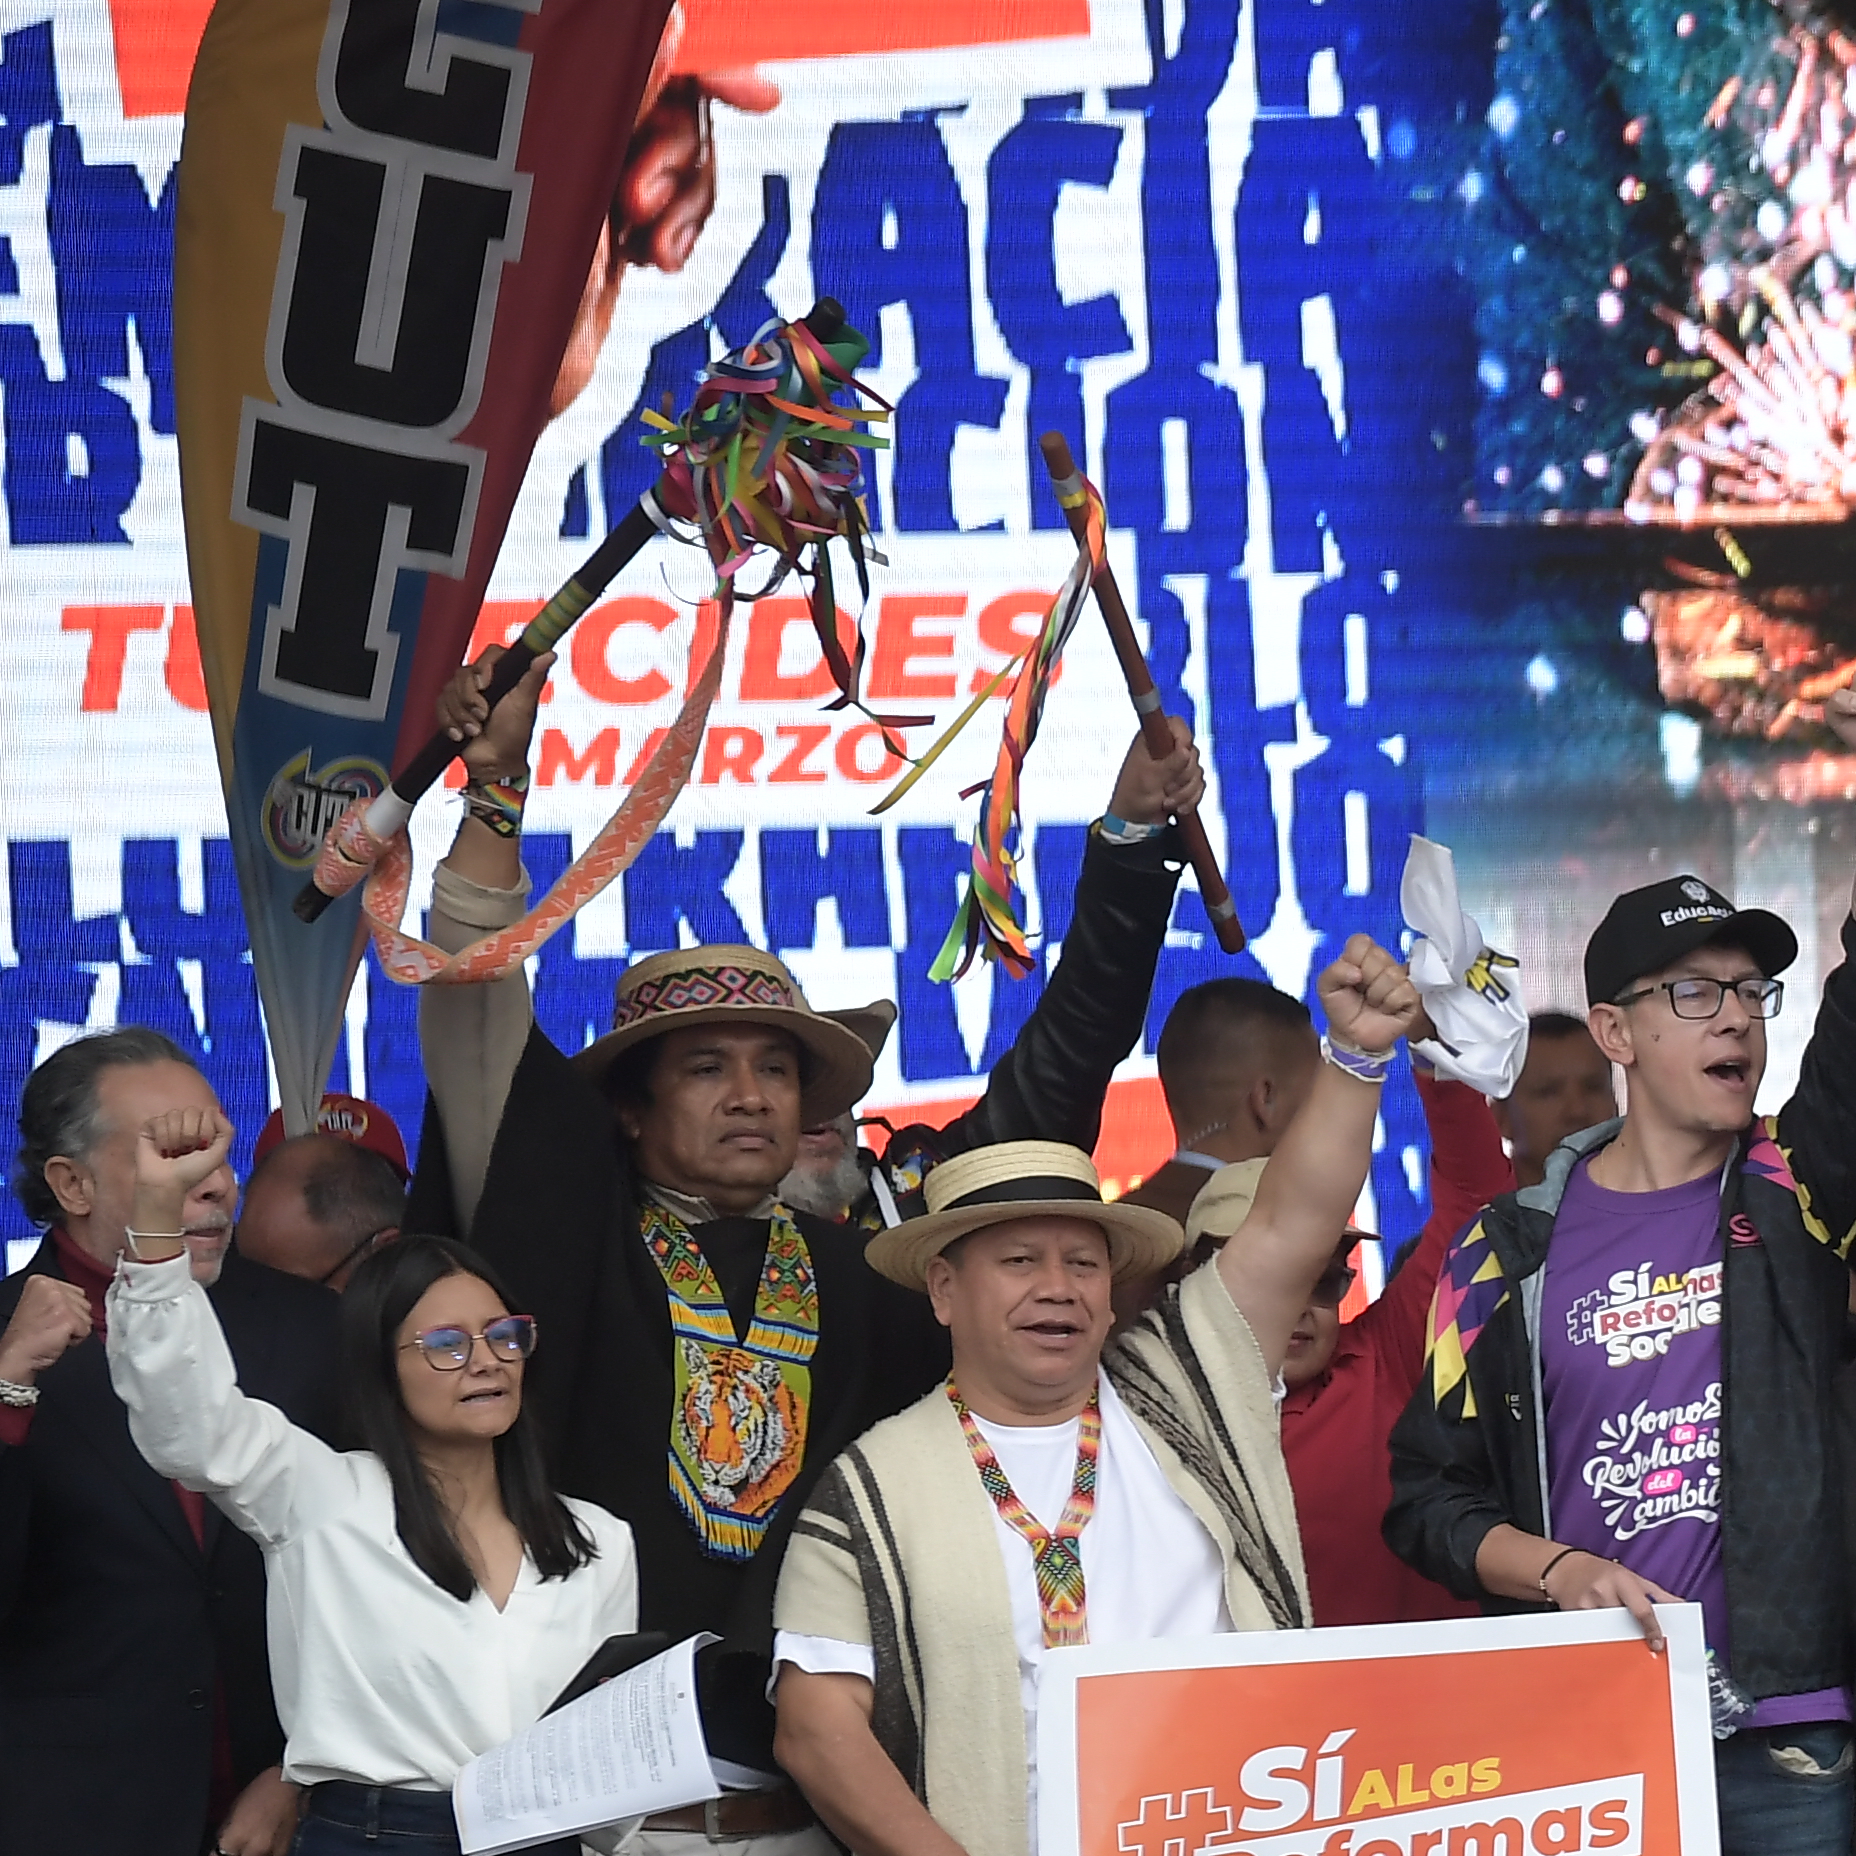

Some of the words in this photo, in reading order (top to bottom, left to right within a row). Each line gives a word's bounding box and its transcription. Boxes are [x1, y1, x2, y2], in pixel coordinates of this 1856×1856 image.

[534, 722, 910, 787] MARZO
[1583, 1427, 1721, 1499] Revolució
[1647, 1472, 1675, 1491] del
